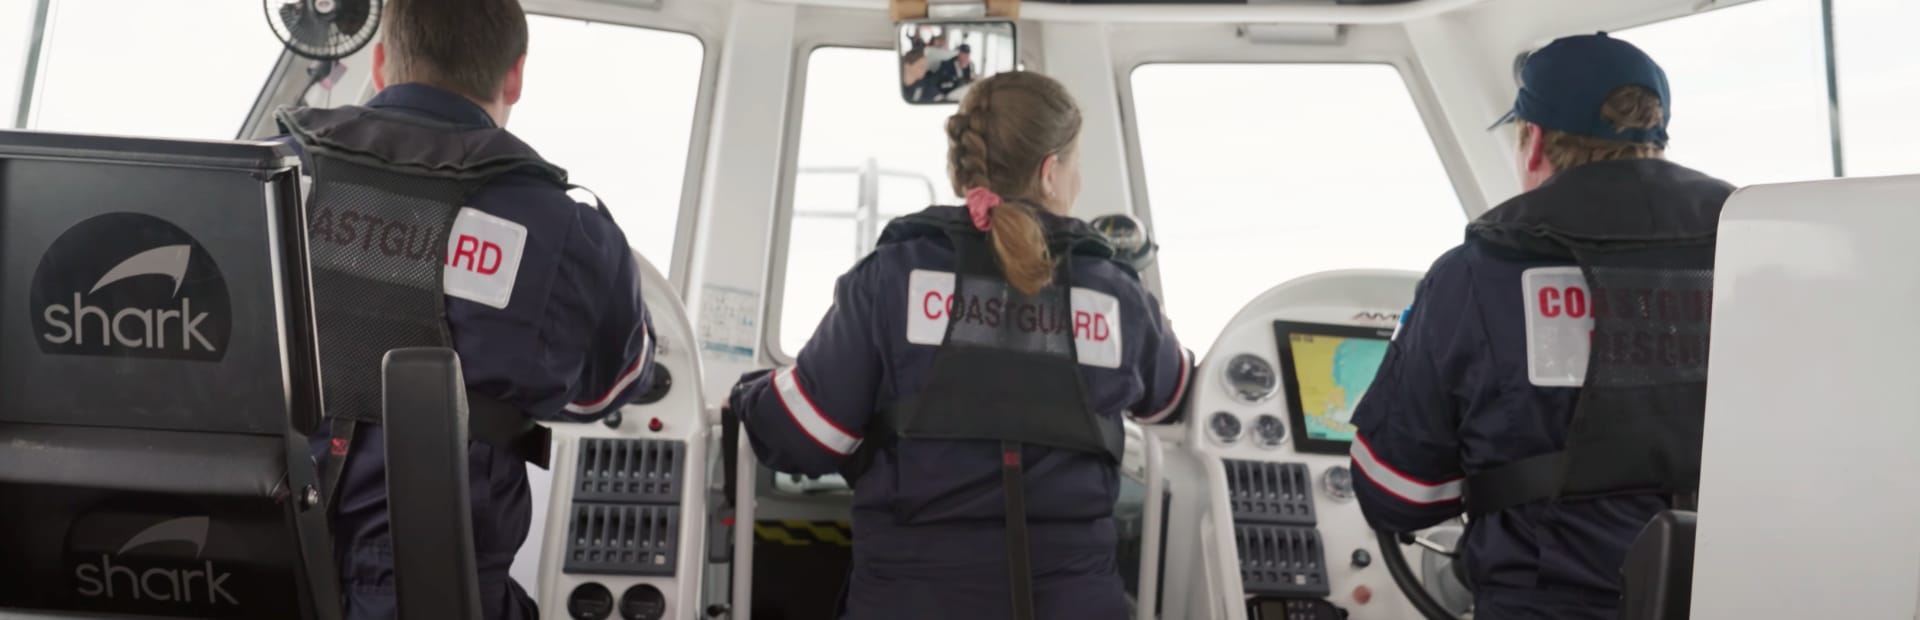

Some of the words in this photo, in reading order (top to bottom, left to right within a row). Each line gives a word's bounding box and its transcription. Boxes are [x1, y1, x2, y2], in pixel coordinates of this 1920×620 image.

[307, 205, 503, 276] ASTGUARD
[43, 291, 216, 351] shark
[1537, 285, 1714, 322] COASTGU
[1587, 328, 1711, 368] RESCU
[75, 553, 239, 605] shark
